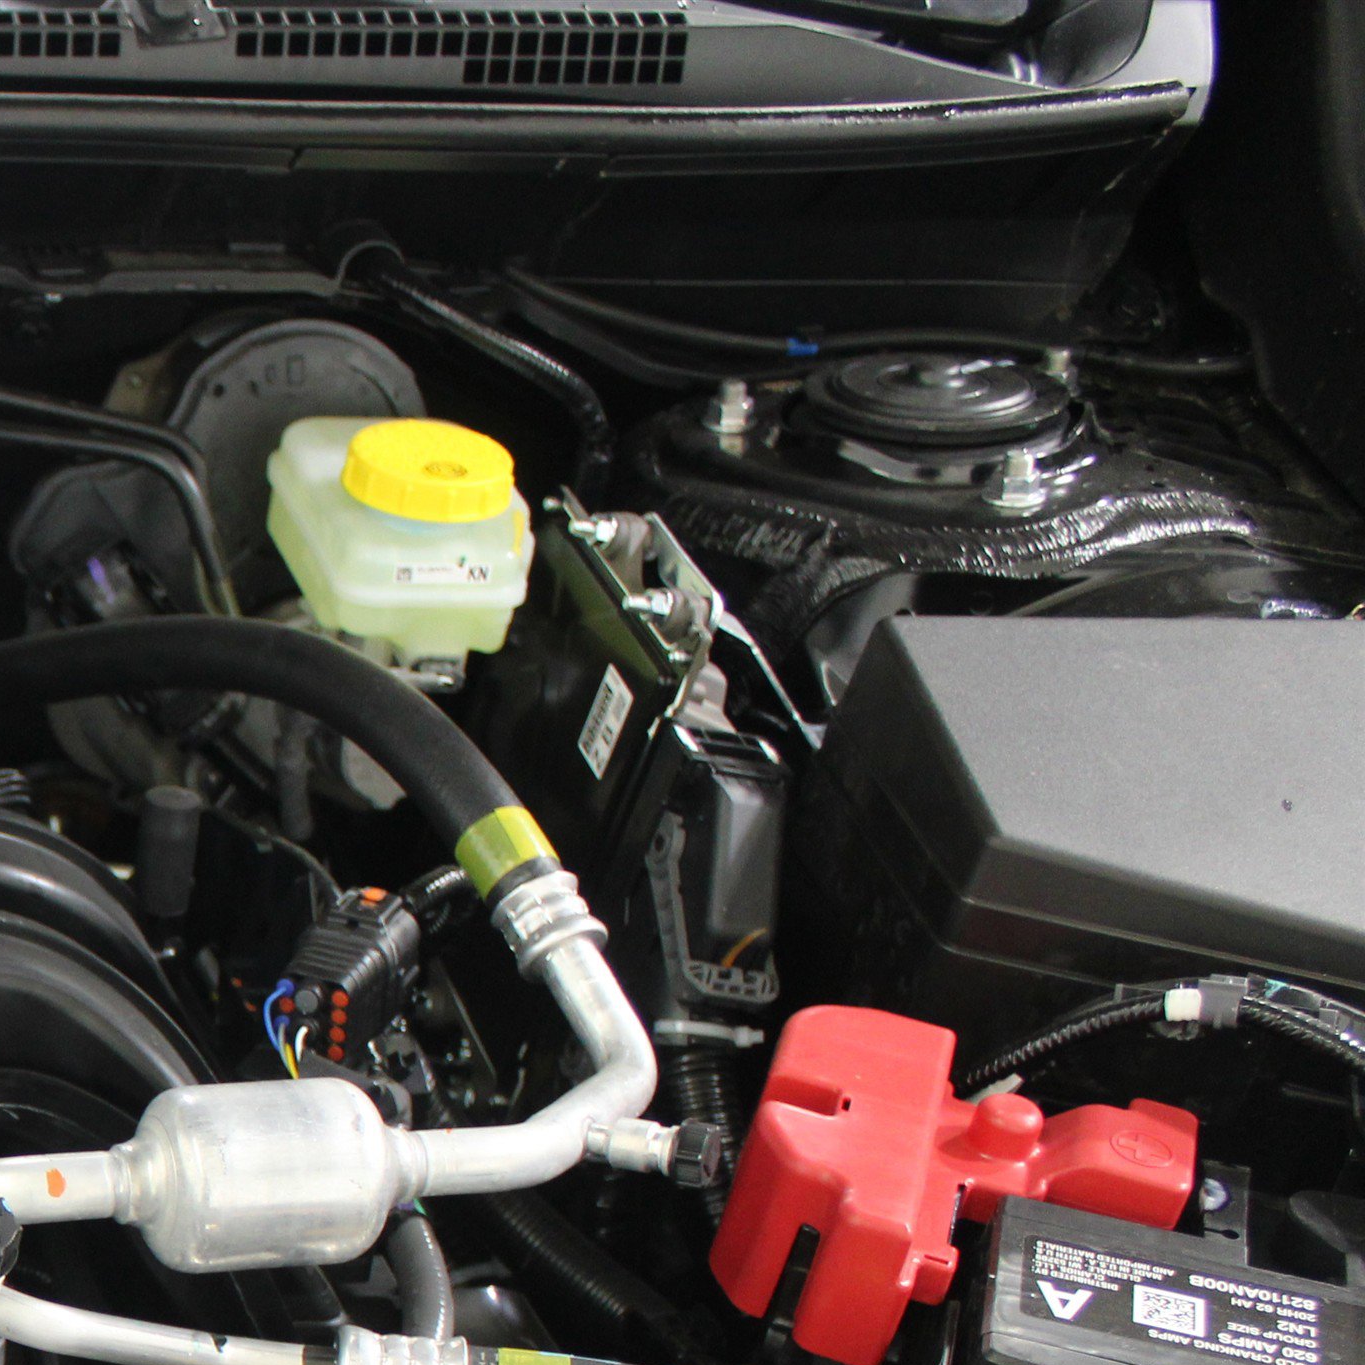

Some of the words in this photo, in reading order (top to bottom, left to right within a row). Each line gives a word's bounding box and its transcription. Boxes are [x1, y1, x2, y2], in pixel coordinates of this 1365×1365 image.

[468, 565, 489, 581] KN
[1036, 1240, 1096, 1259] MATERIALS
[1096, 1253, 1151, 1272] IMPORTED
[1132, 1269, 1164, 1281] MADE
[1152, 1266, 1175, 1277] AND
[1050, 1270, 1119, 1291] DISTRIBUTED
[1188, 1275, 1317, 1311] 82110AN00B
[1231, 1297, 1253, 1309] AH
[1255, 1302, 1274, 1313] 62
[1276, 1307, 1316, 1322] 20HR
[1226, 1322, 1261, 1336] SIZE
[1276, 1320, 1316, 1337] LN2
[1148, 1329, 1191, 1345] AMPS
[1217, 1333, 1278, 1354] AMPS
[1262, 1331, 1317, 1348] GROUP
[1193, 1340, 1274, 1364] CRANKING
[1282, 1347, 1318, 1363] 620
